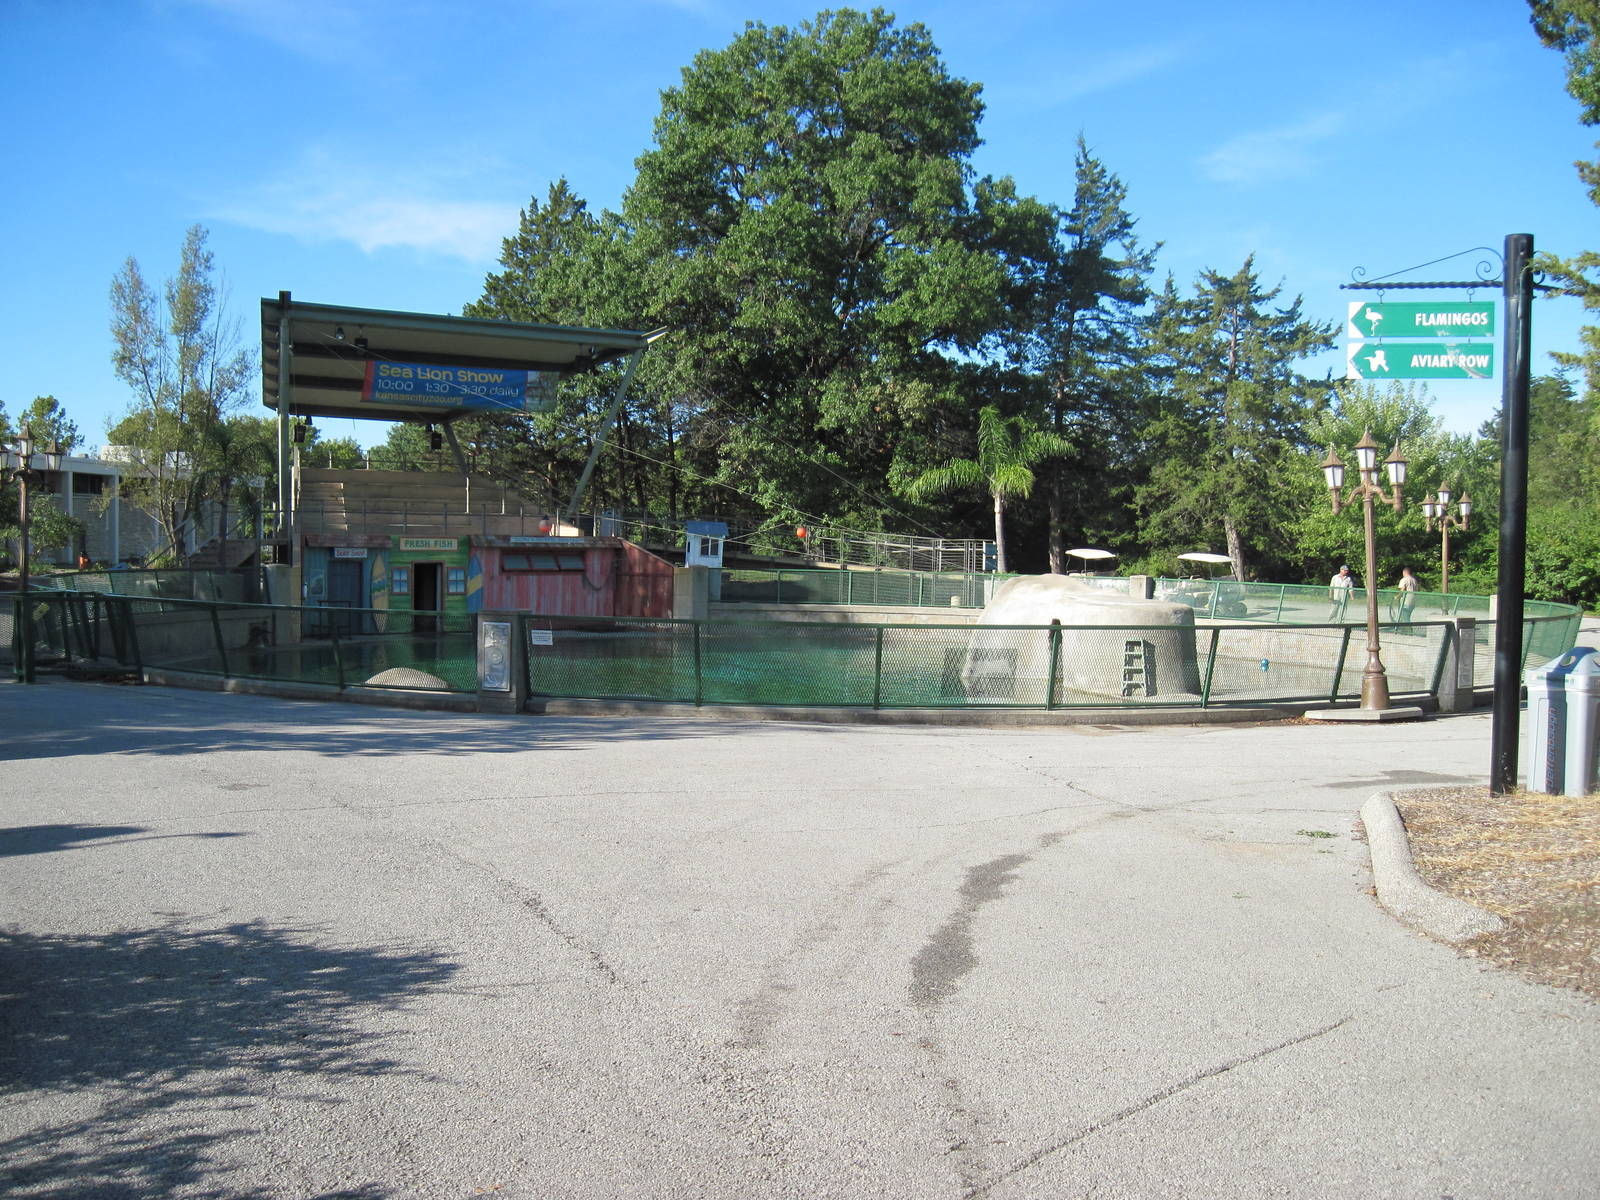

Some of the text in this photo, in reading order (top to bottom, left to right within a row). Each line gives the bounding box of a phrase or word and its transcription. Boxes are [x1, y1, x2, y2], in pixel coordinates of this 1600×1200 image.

[1415, 312, 1489, 326] FLAMINGOS
[1410, 354, 1490, 368] AVIARY ROW
[379, 364, 504, 384] Sea Lion Show
[377, 379, 519, 398] 10:00 1:30 3:30 daily
[404, 539, 454, 549] FRESH FISH
